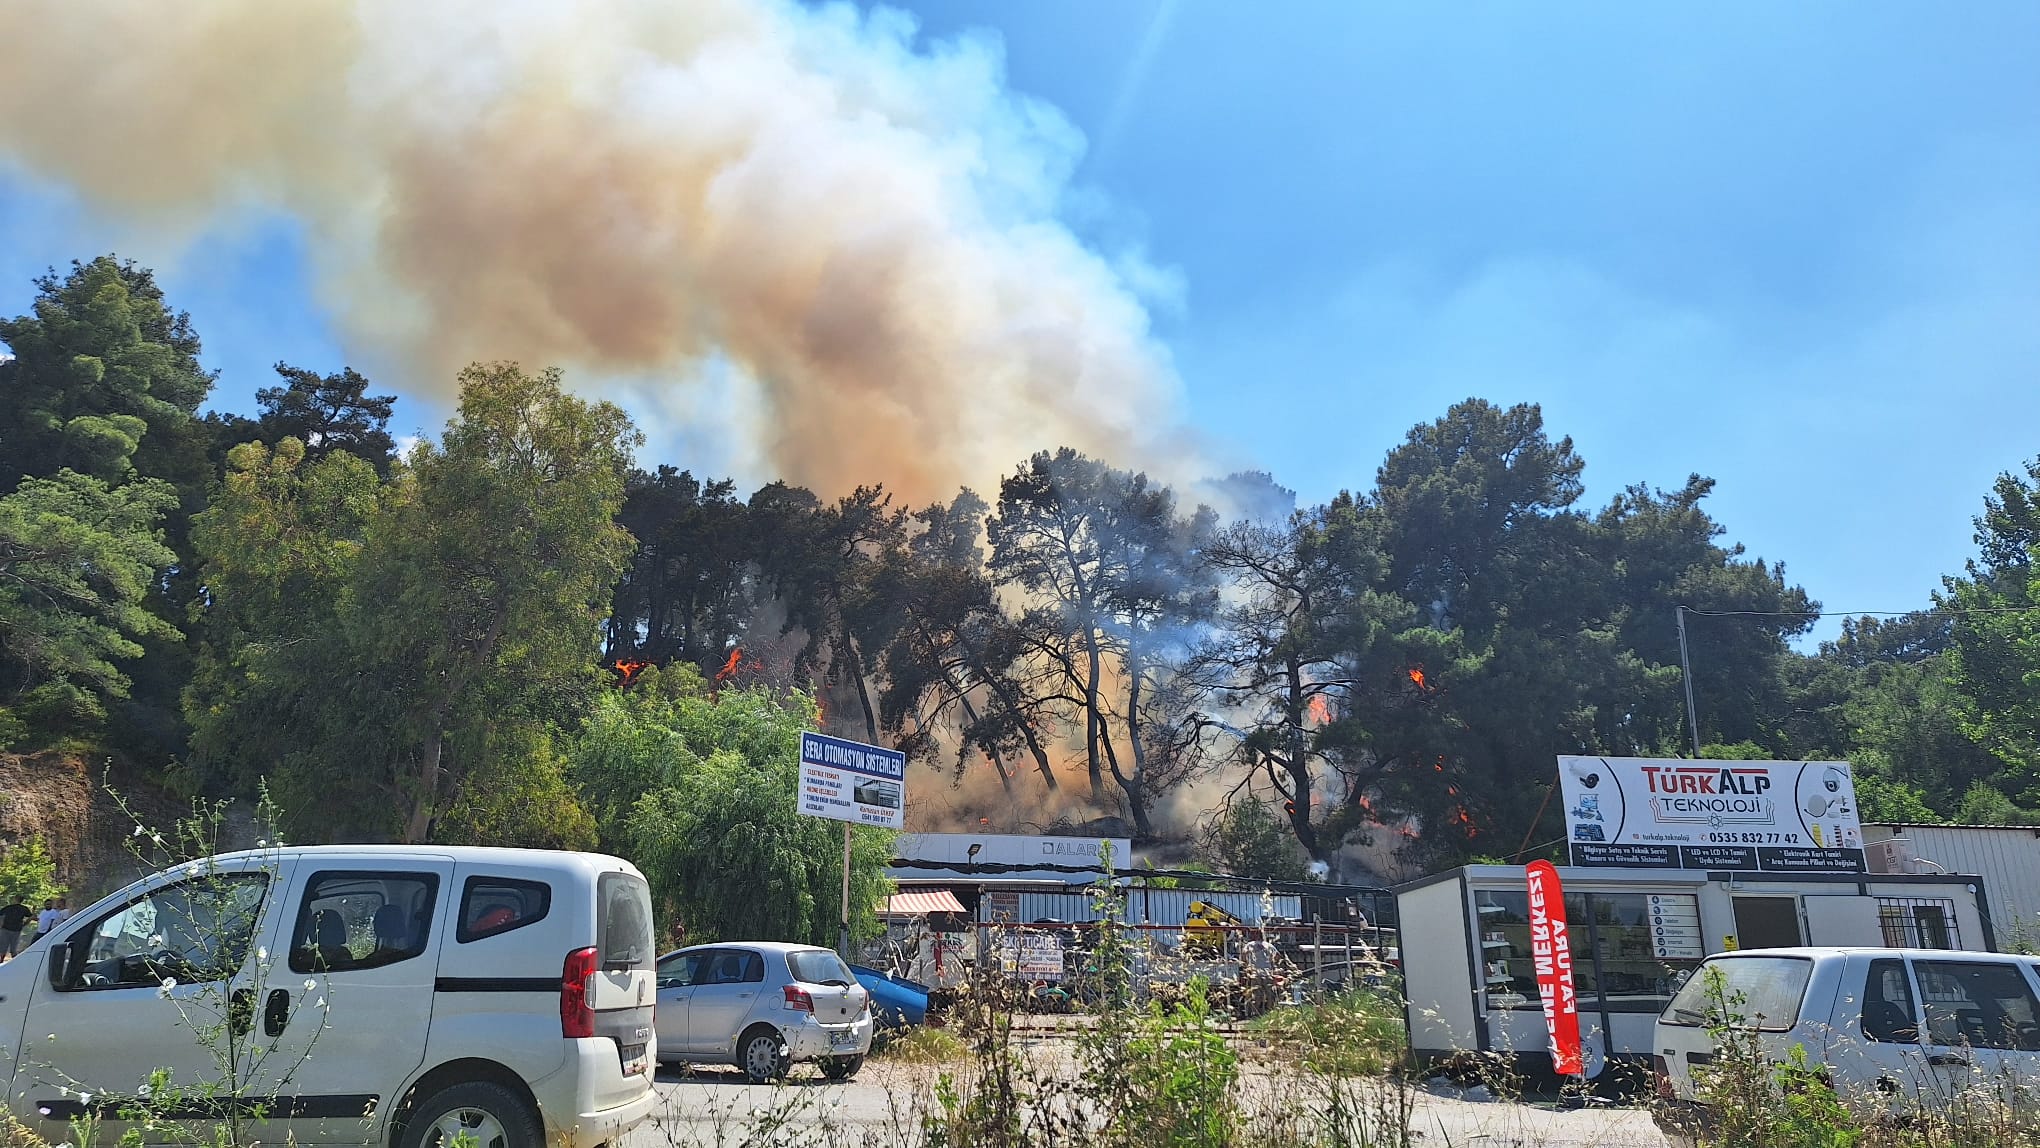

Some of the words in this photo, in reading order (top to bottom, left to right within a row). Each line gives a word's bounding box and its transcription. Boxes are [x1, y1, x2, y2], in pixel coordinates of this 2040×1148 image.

[805, 740, 823, 760] SERA
[825, 744, 864, 769] OTOMASYON
[866, 748, 902, 776] SİSTEMLERİ
[1641, 767, 1770, 794] TÜRKALP
[1660, 797, 1761, 813] TEKNOLOJİ
[1710, 833, 1738, 843] 0535
[1742, 833, 1763, 843] 832
[1767, 833, 1779, 843] 77
[1785, 834, 1798, 844] 42
[1056, 843, 1118, 857] ALARO
[1583, 846, 1607, 854] Bilgisayar
[1699, 857, 1713, 865] Uydu
